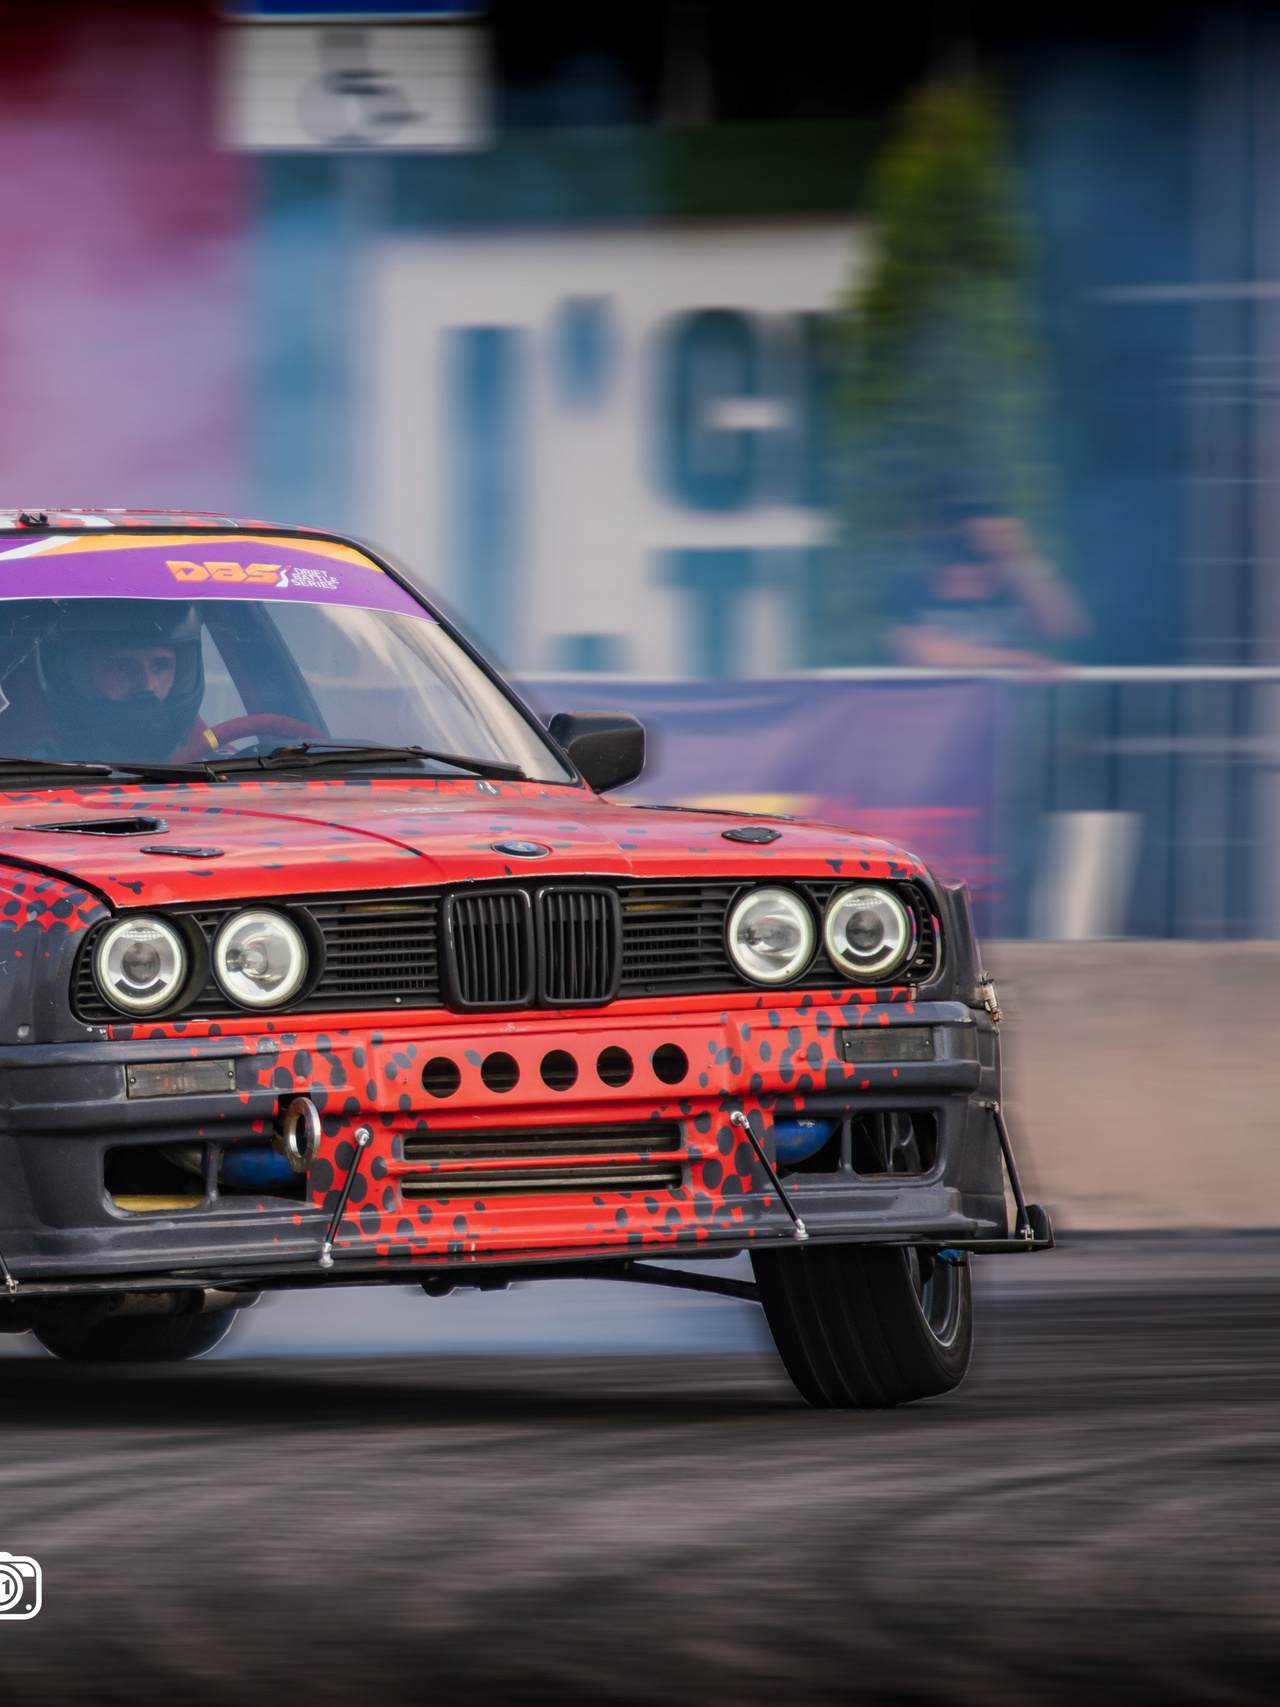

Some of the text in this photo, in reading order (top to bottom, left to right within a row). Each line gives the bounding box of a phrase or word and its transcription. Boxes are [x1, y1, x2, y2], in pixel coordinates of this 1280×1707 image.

[165, 560, 282, 585] DBS
[294, 567, 327, 577] DRIFT
[291, 573, 339, 584] BATTLE
[291, 579, 337, 589] SERIES
